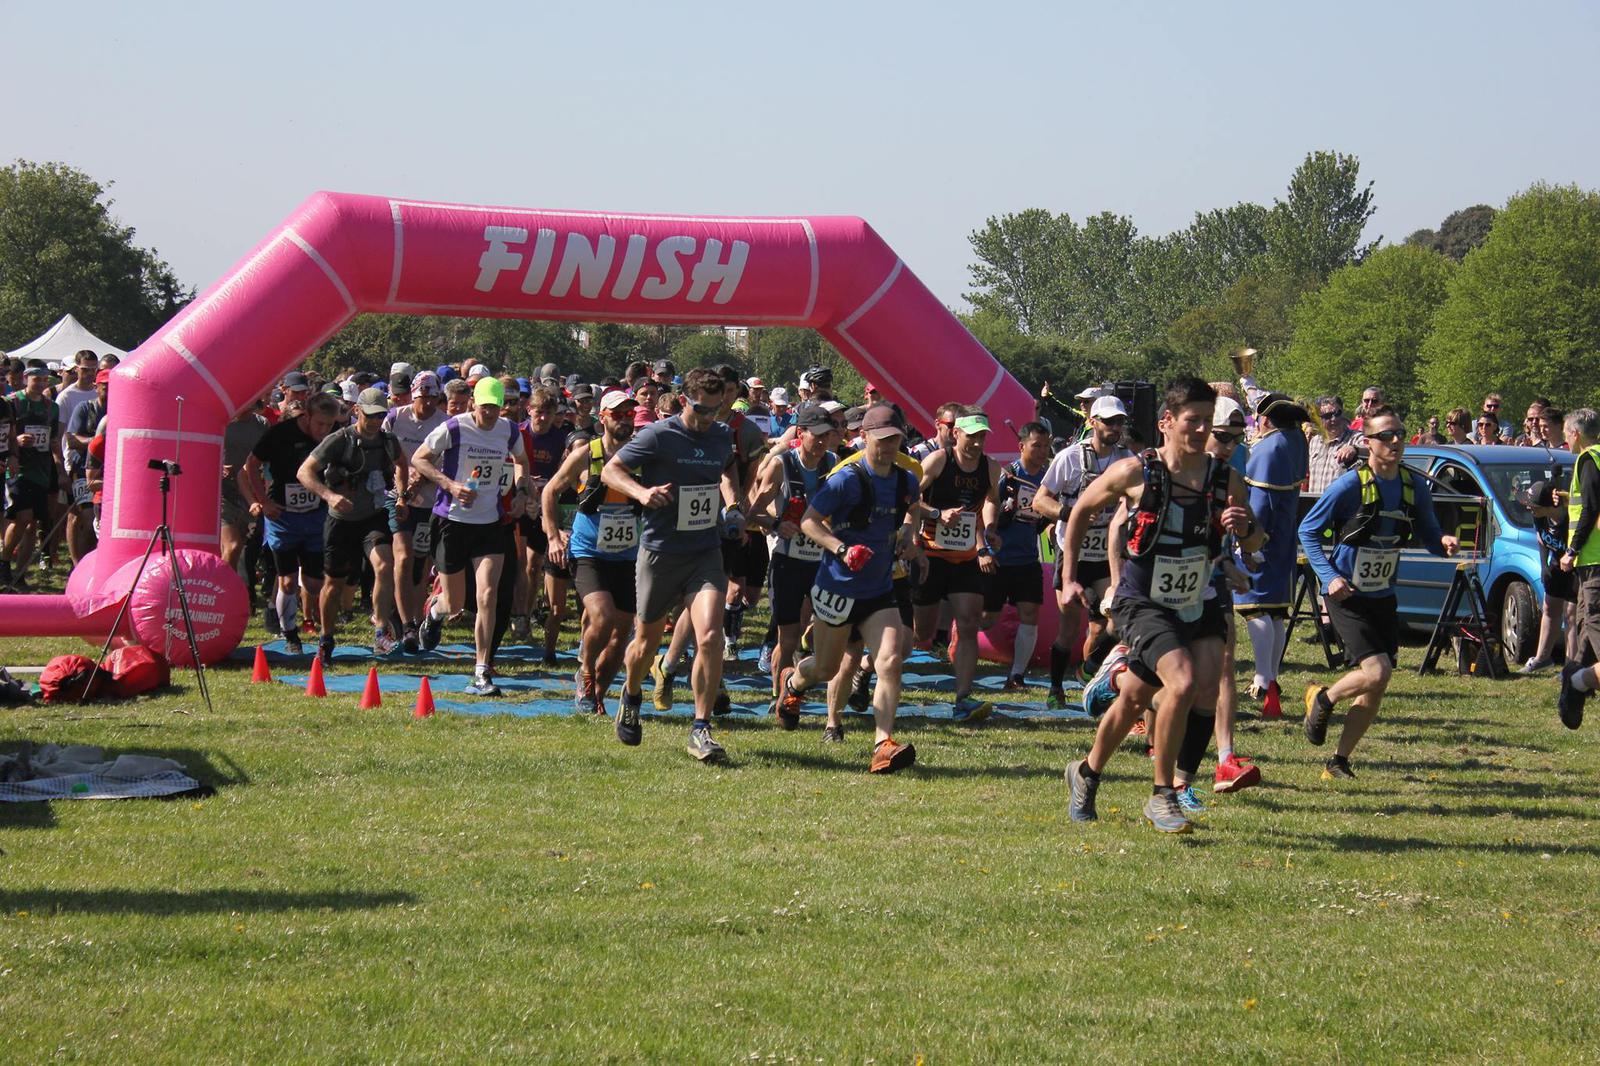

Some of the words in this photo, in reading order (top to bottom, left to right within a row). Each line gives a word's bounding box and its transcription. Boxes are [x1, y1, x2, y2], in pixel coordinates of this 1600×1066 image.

[474, 226, 750, 304] FINISH
[290, 492, 316, 505] 390
[690, 498, 711, 516] 94
[603, 526, 634, 541] 345
[1360, 562, 1392, 578] 330
[1159, 572, 1198, 593] 342
[165, 608, 225, 625] ENTETAINMENTS
